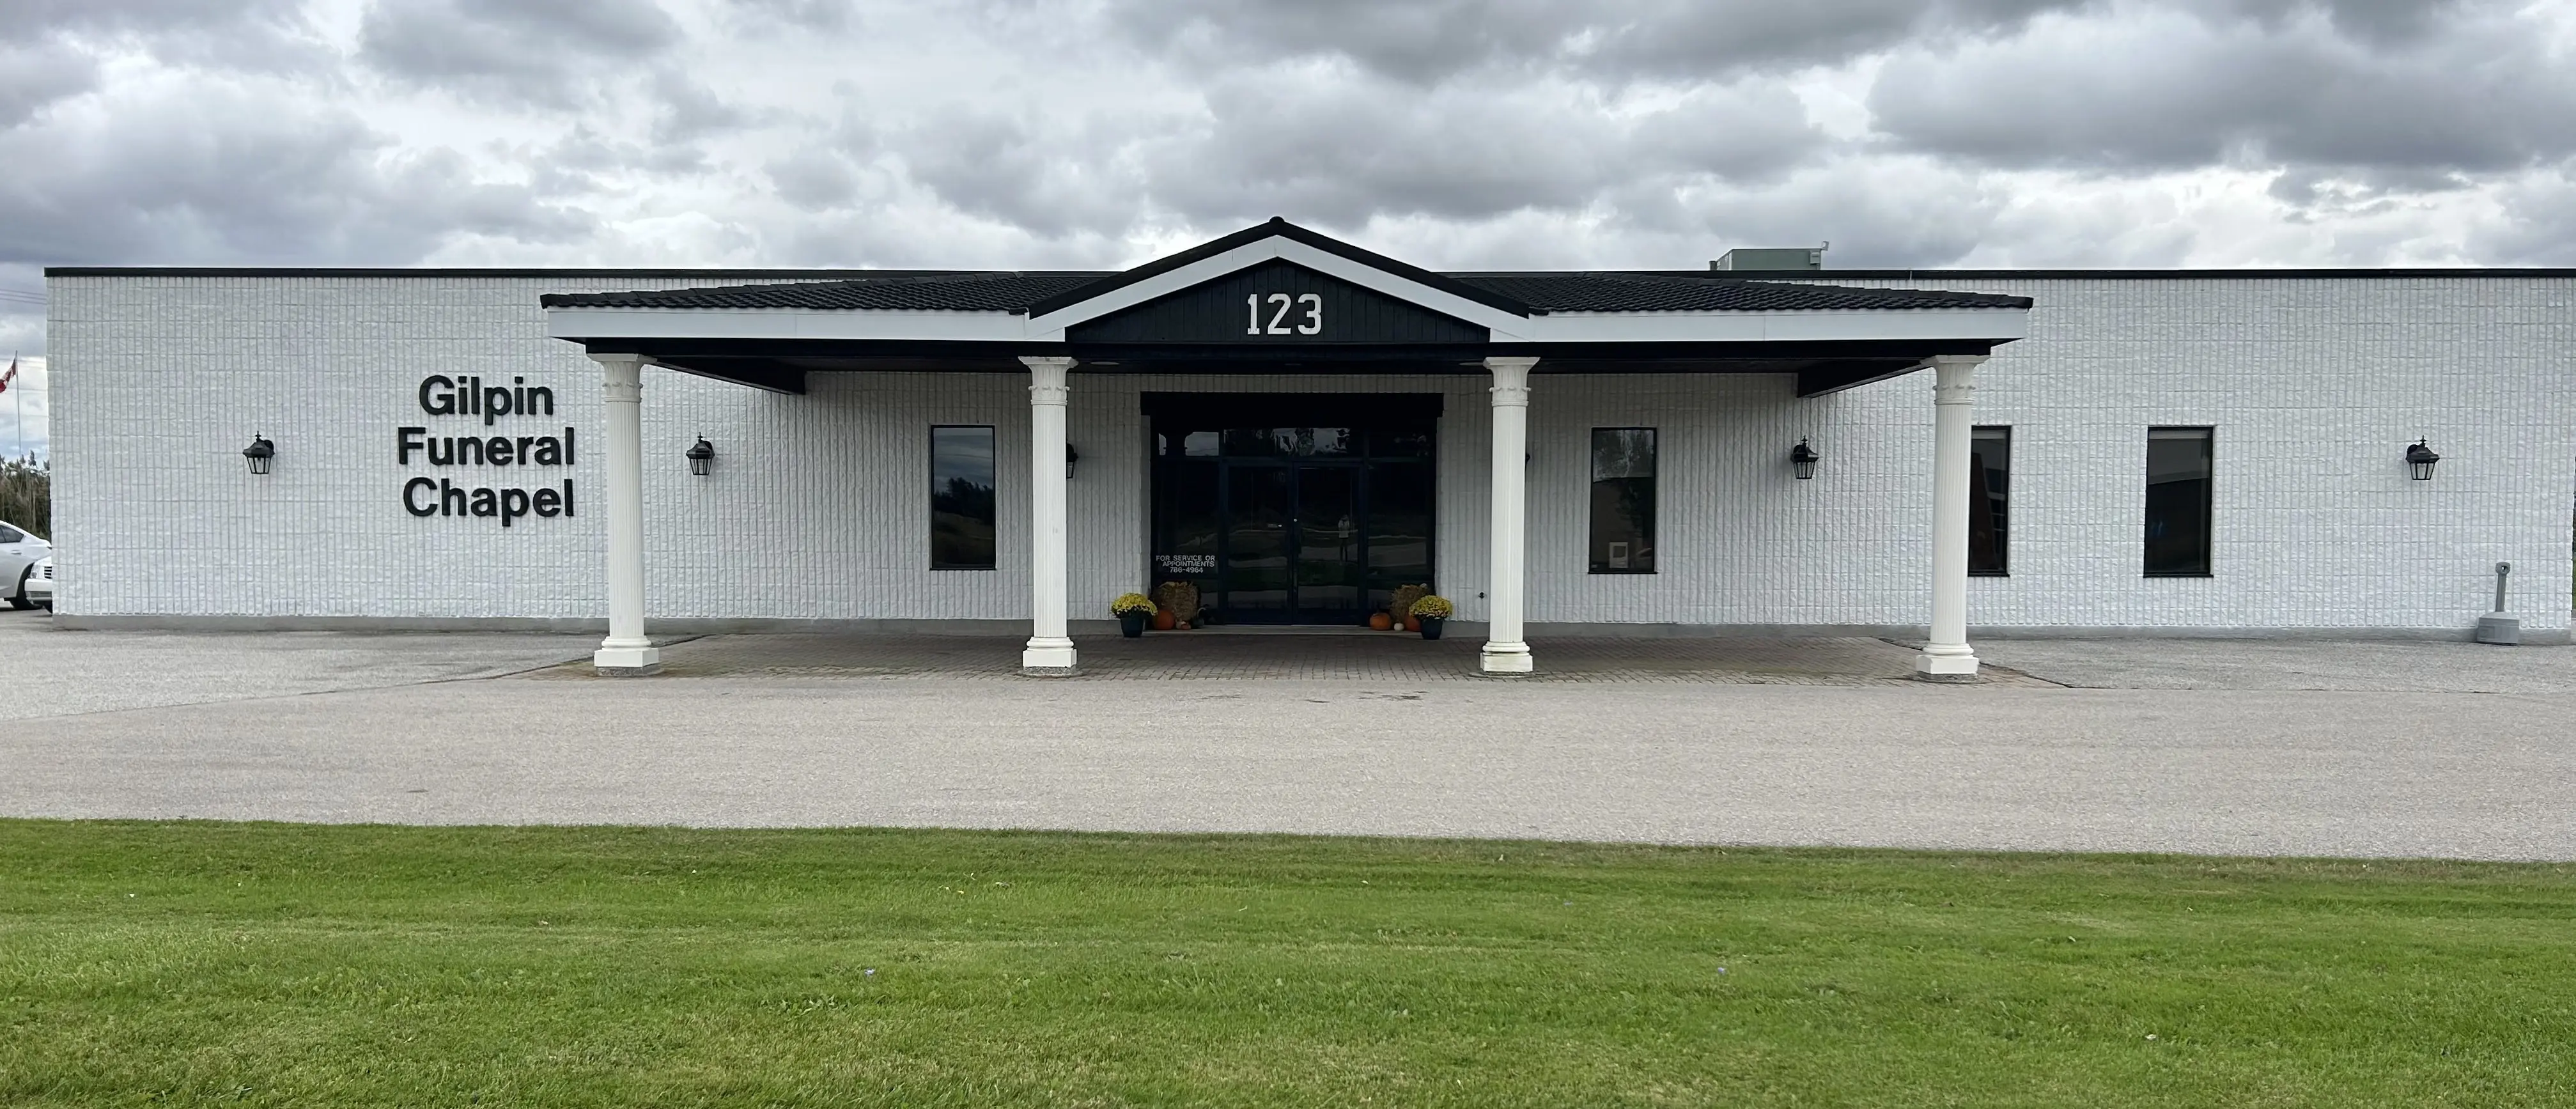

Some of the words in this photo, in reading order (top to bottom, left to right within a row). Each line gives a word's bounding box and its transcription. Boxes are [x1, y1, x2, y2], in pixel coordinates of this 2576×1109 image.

[1247, 293, 1323, 335] 123
[419, 375, 554, 426] Gilpin
[398, 426, 574, 465] Funeral
[403, 477, 574, 527] Chapel
